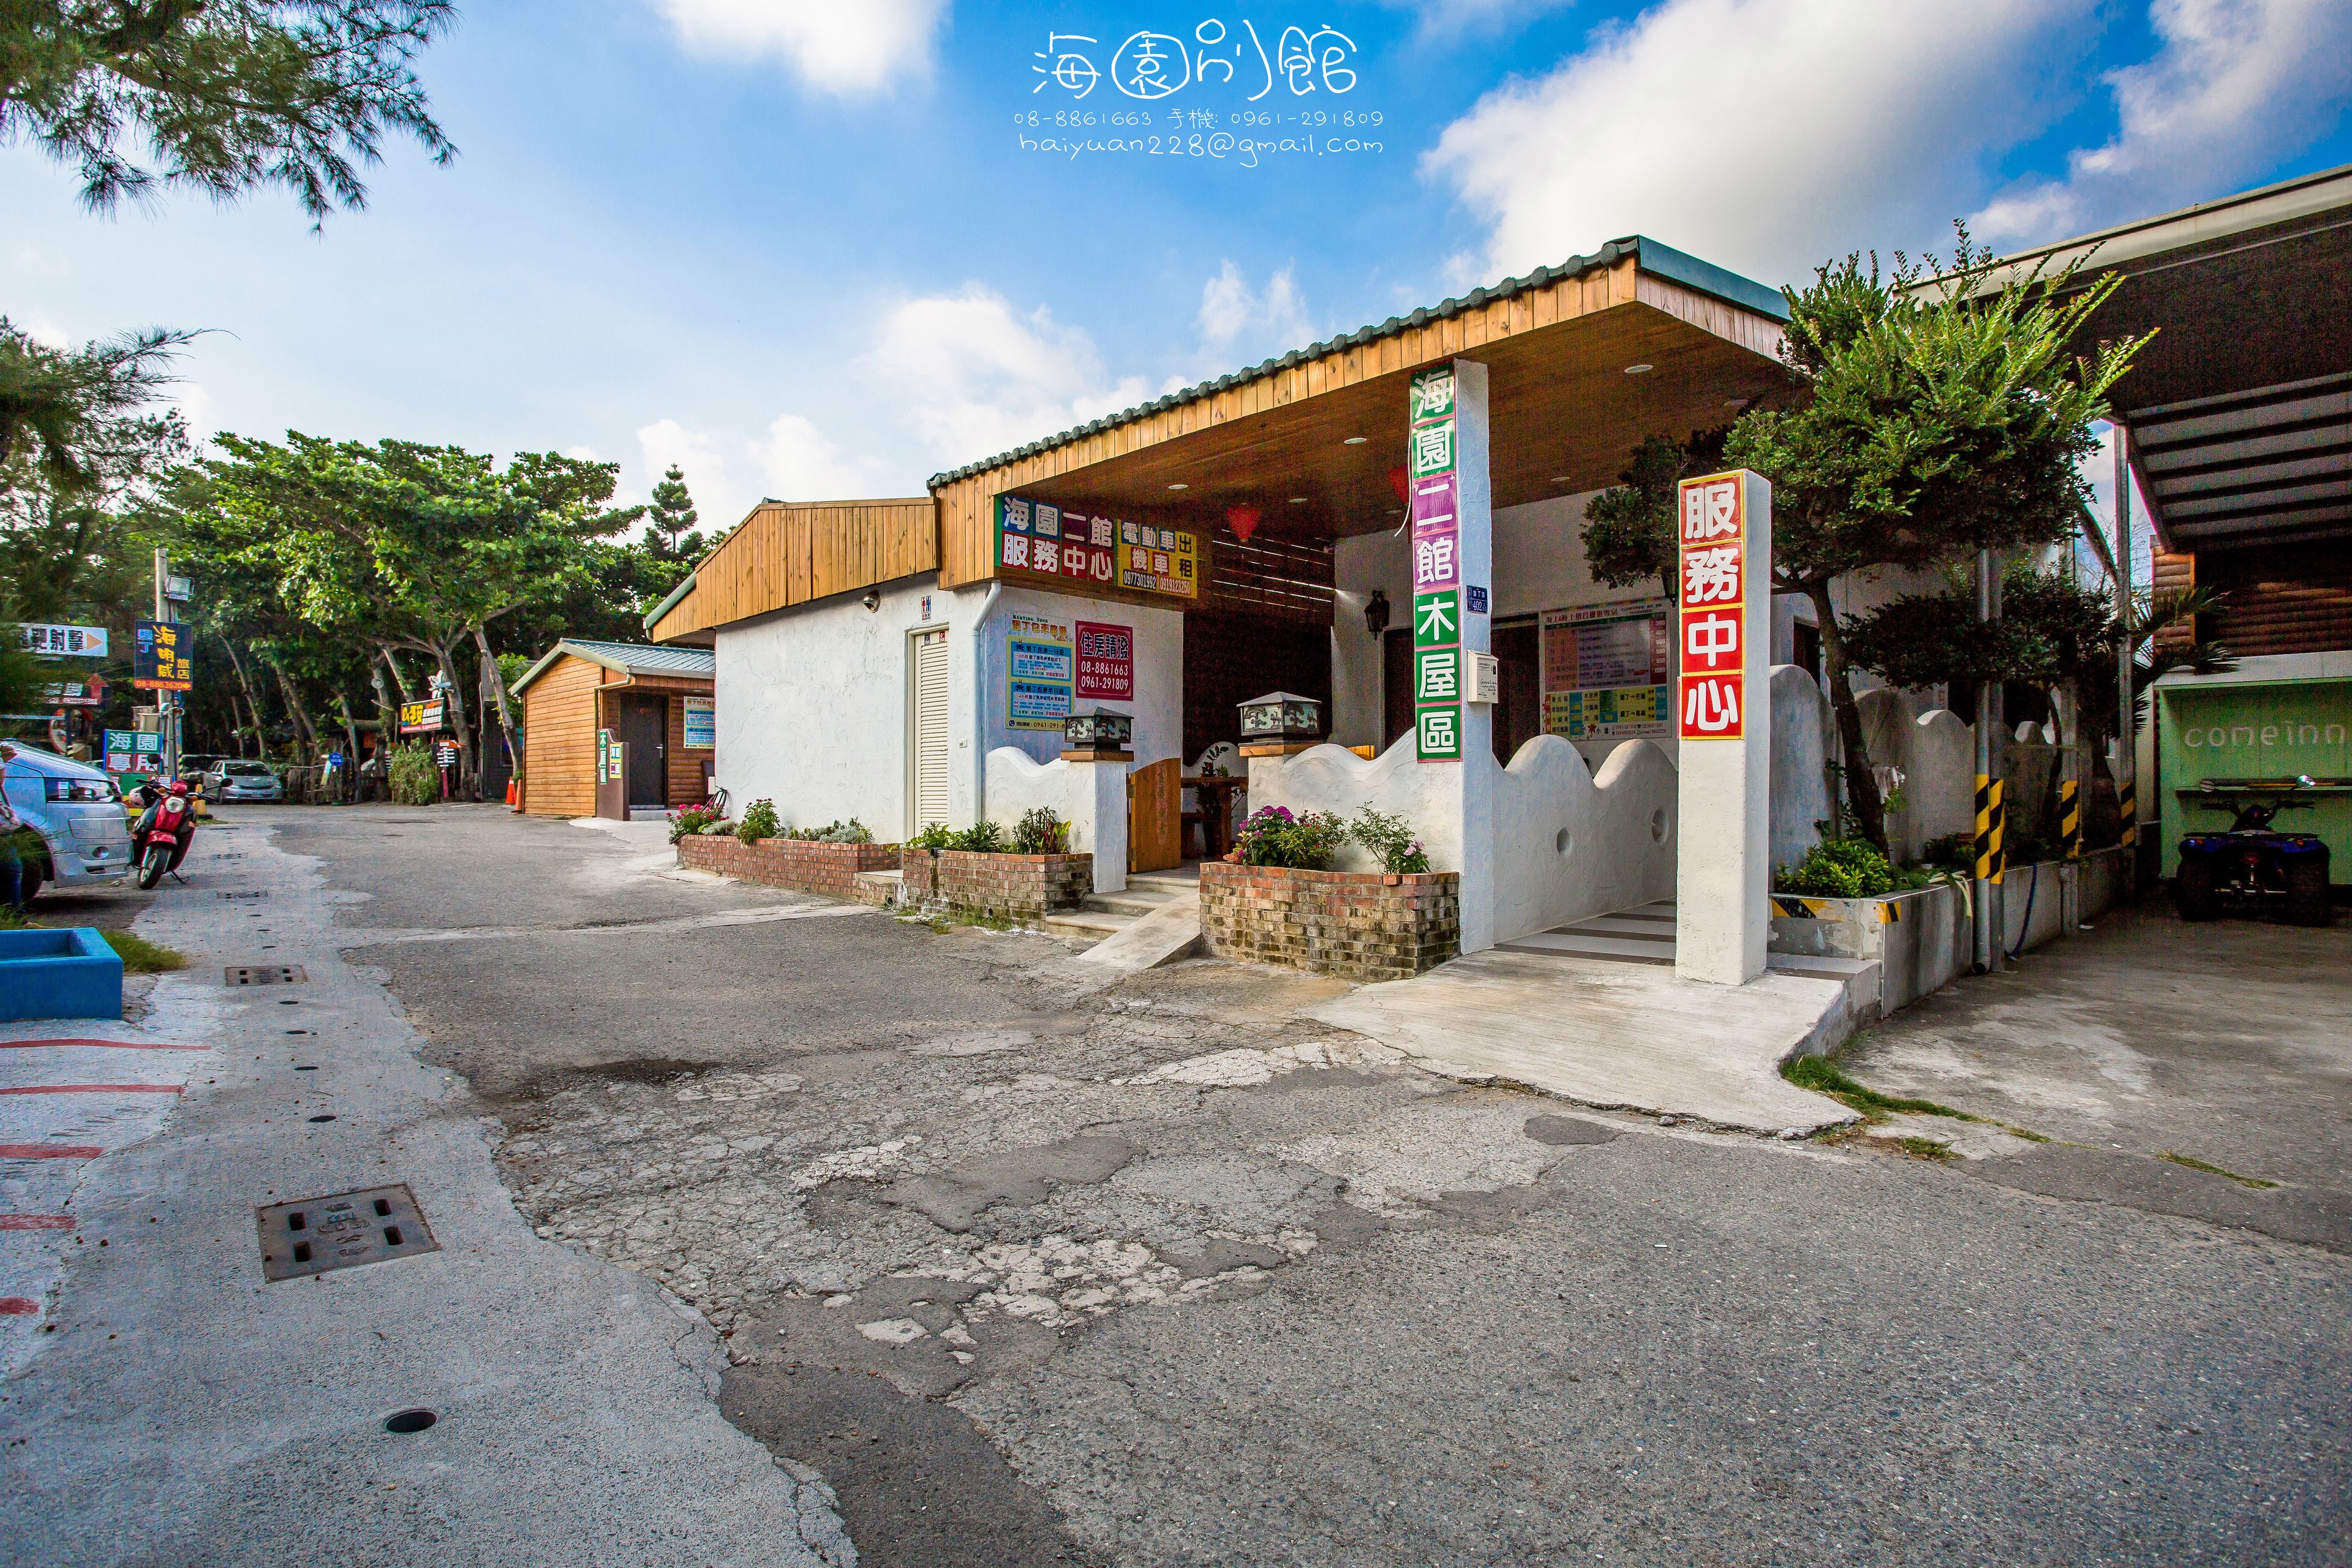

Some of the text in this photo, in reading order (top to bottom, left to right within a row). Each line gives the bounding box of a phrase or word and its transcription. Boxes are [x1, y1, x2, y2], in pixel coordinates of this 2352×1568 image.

[1004, 497, 1114, 548] 海園二館
[1122, 522, 1174, 551] 電動車
[1003, 533, 1113, 581] 服務中心
[1133, 548, 1169, 574] 機車
[1684, 481, 1739, 731] 服務中心
[1080, 631, 1129, 660] 住房請撥
[1081, 660, 1128, 676] 08-8861663
[1081, 675, 1128, 690] 0961-291809
[109, 732, 159, 751] 海園
